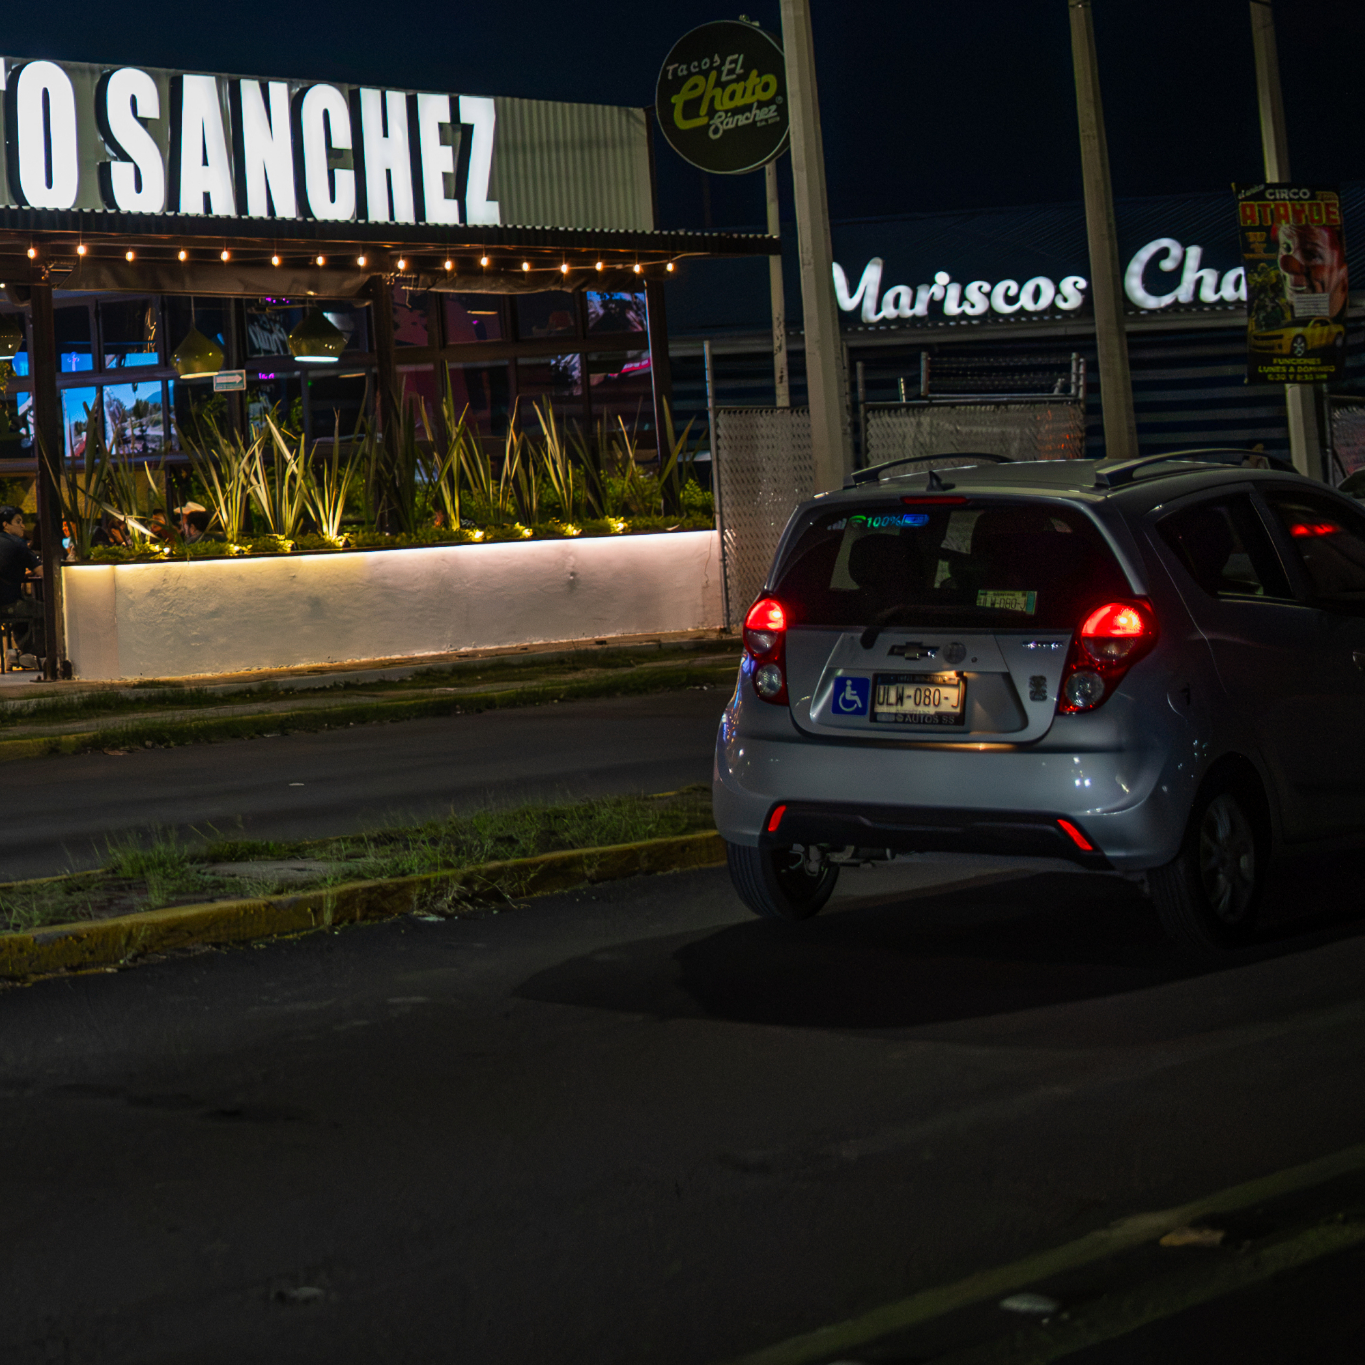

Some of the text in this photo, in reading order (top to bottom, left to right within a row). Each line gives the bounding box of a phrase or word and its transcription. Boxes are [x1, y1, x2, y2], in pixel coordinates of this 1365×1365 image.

[666, 53, 720, 80] Tacos
[671, 69, 777, 130] Chato
[708, 101, 778, 140] Sánchez
[101, 67, 499, 226] SANCHEZ
[1265, 188, 1310, 200] CIRCO
[1239, 201, 1340, 226] ATAYDE
[833, 257, 1087, 324] Mariscos
[904, 713, 940, 725] AUTOS
